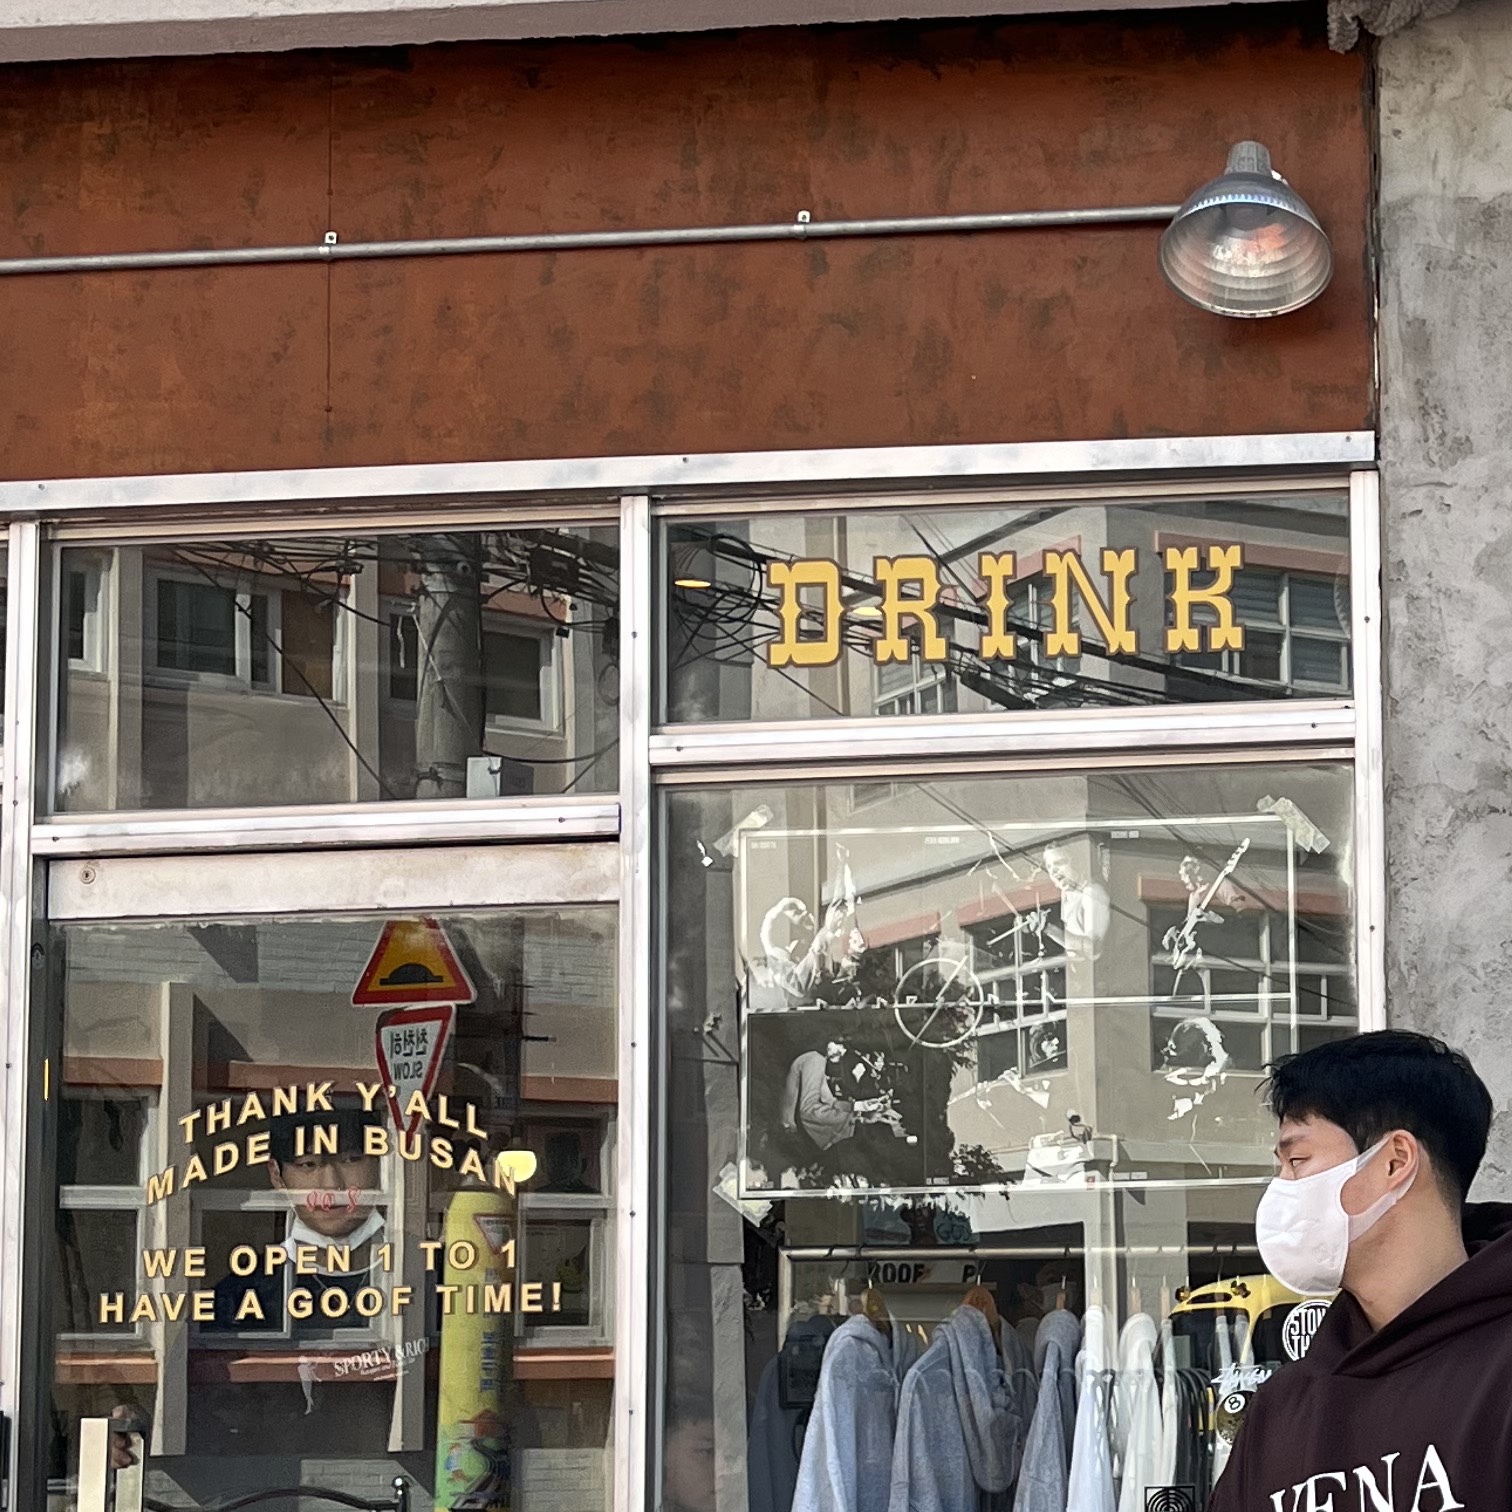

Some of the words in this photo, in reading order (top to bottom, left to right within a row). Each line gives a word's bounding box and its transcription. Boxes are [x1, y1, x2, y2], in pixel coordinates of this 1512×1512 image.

[766, 543, 1246, 670] DRINK
[178, 1080, 334, 1144] THANK
[146, 1130, 272, 1206] MADE
[294, 1124, 339, 1157] IN
[363, 1124, 518, 1199] BUSAN
[143, 1246, 206, 1279] WE
[229, 1244, 351, 1277] OPEN
[377, 1243, 391, 1272] 1
[419, 1240, 476, 1271] TO
[500, 1238, 517, 1269] 1
[99, 1289, 216, 1324] HAVE
[236, 1288, 265, 1320] A
[287, 1286, 413, 1318] GOOF
[436, 1282, 562, 1315] TIME!
[333, 1347, 391, 1377] SPORTY
